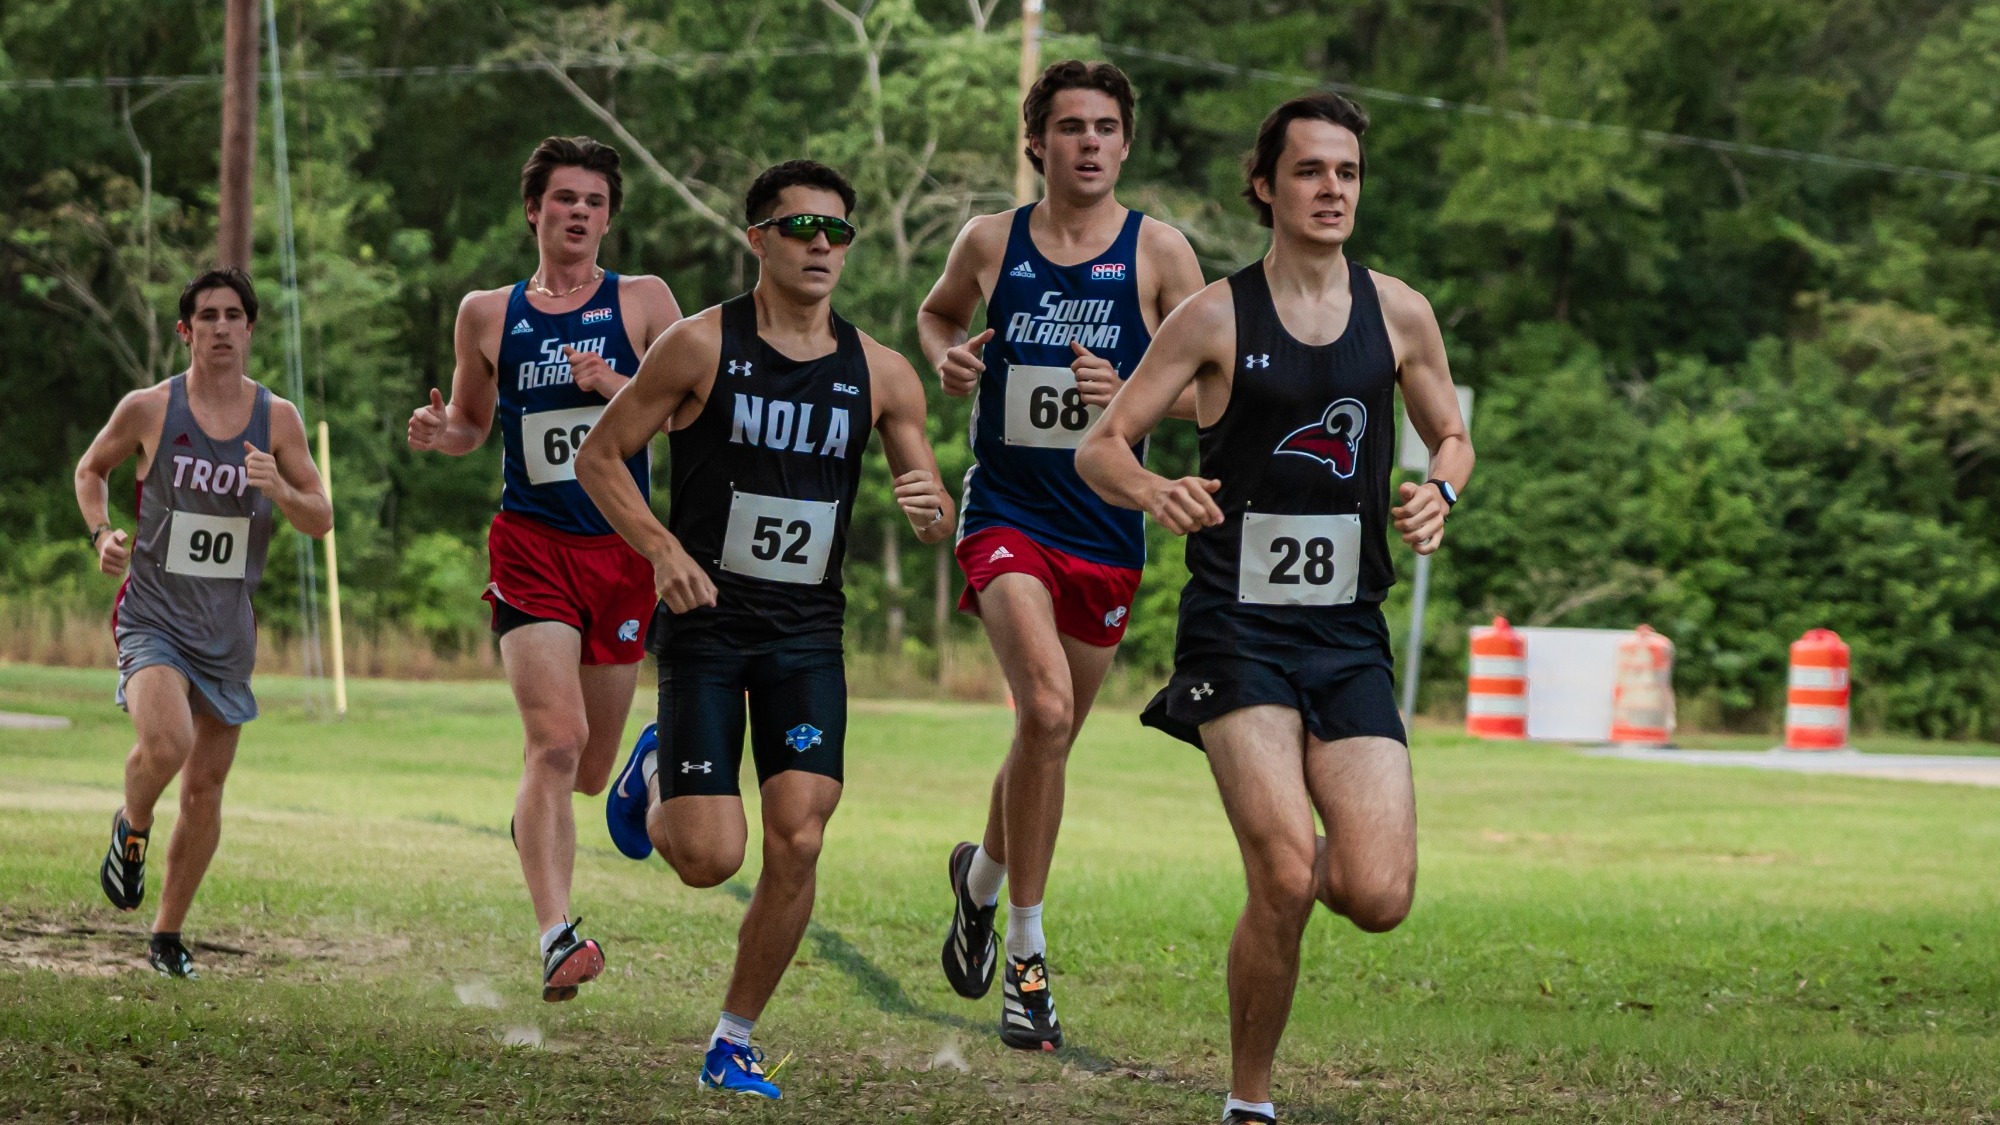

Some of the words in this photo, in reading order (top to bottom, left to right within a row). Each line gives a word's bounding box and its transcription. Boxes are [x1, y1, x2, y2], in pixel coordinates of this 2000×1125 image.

[1009, 270, 1036, 279] adidas
[1091, 263, 1126, 280] SBC
[517, 358, 617, 391] ALAB
[729, 393, 850, 459] NOLA
[1029, 385, 1090, 431] 68
[172, 455, 250, 497] TROY
[188, 529, 234, 564] 90
[751, 515, 812, 565] 52
[1268, 536, 1335, 586] 28
